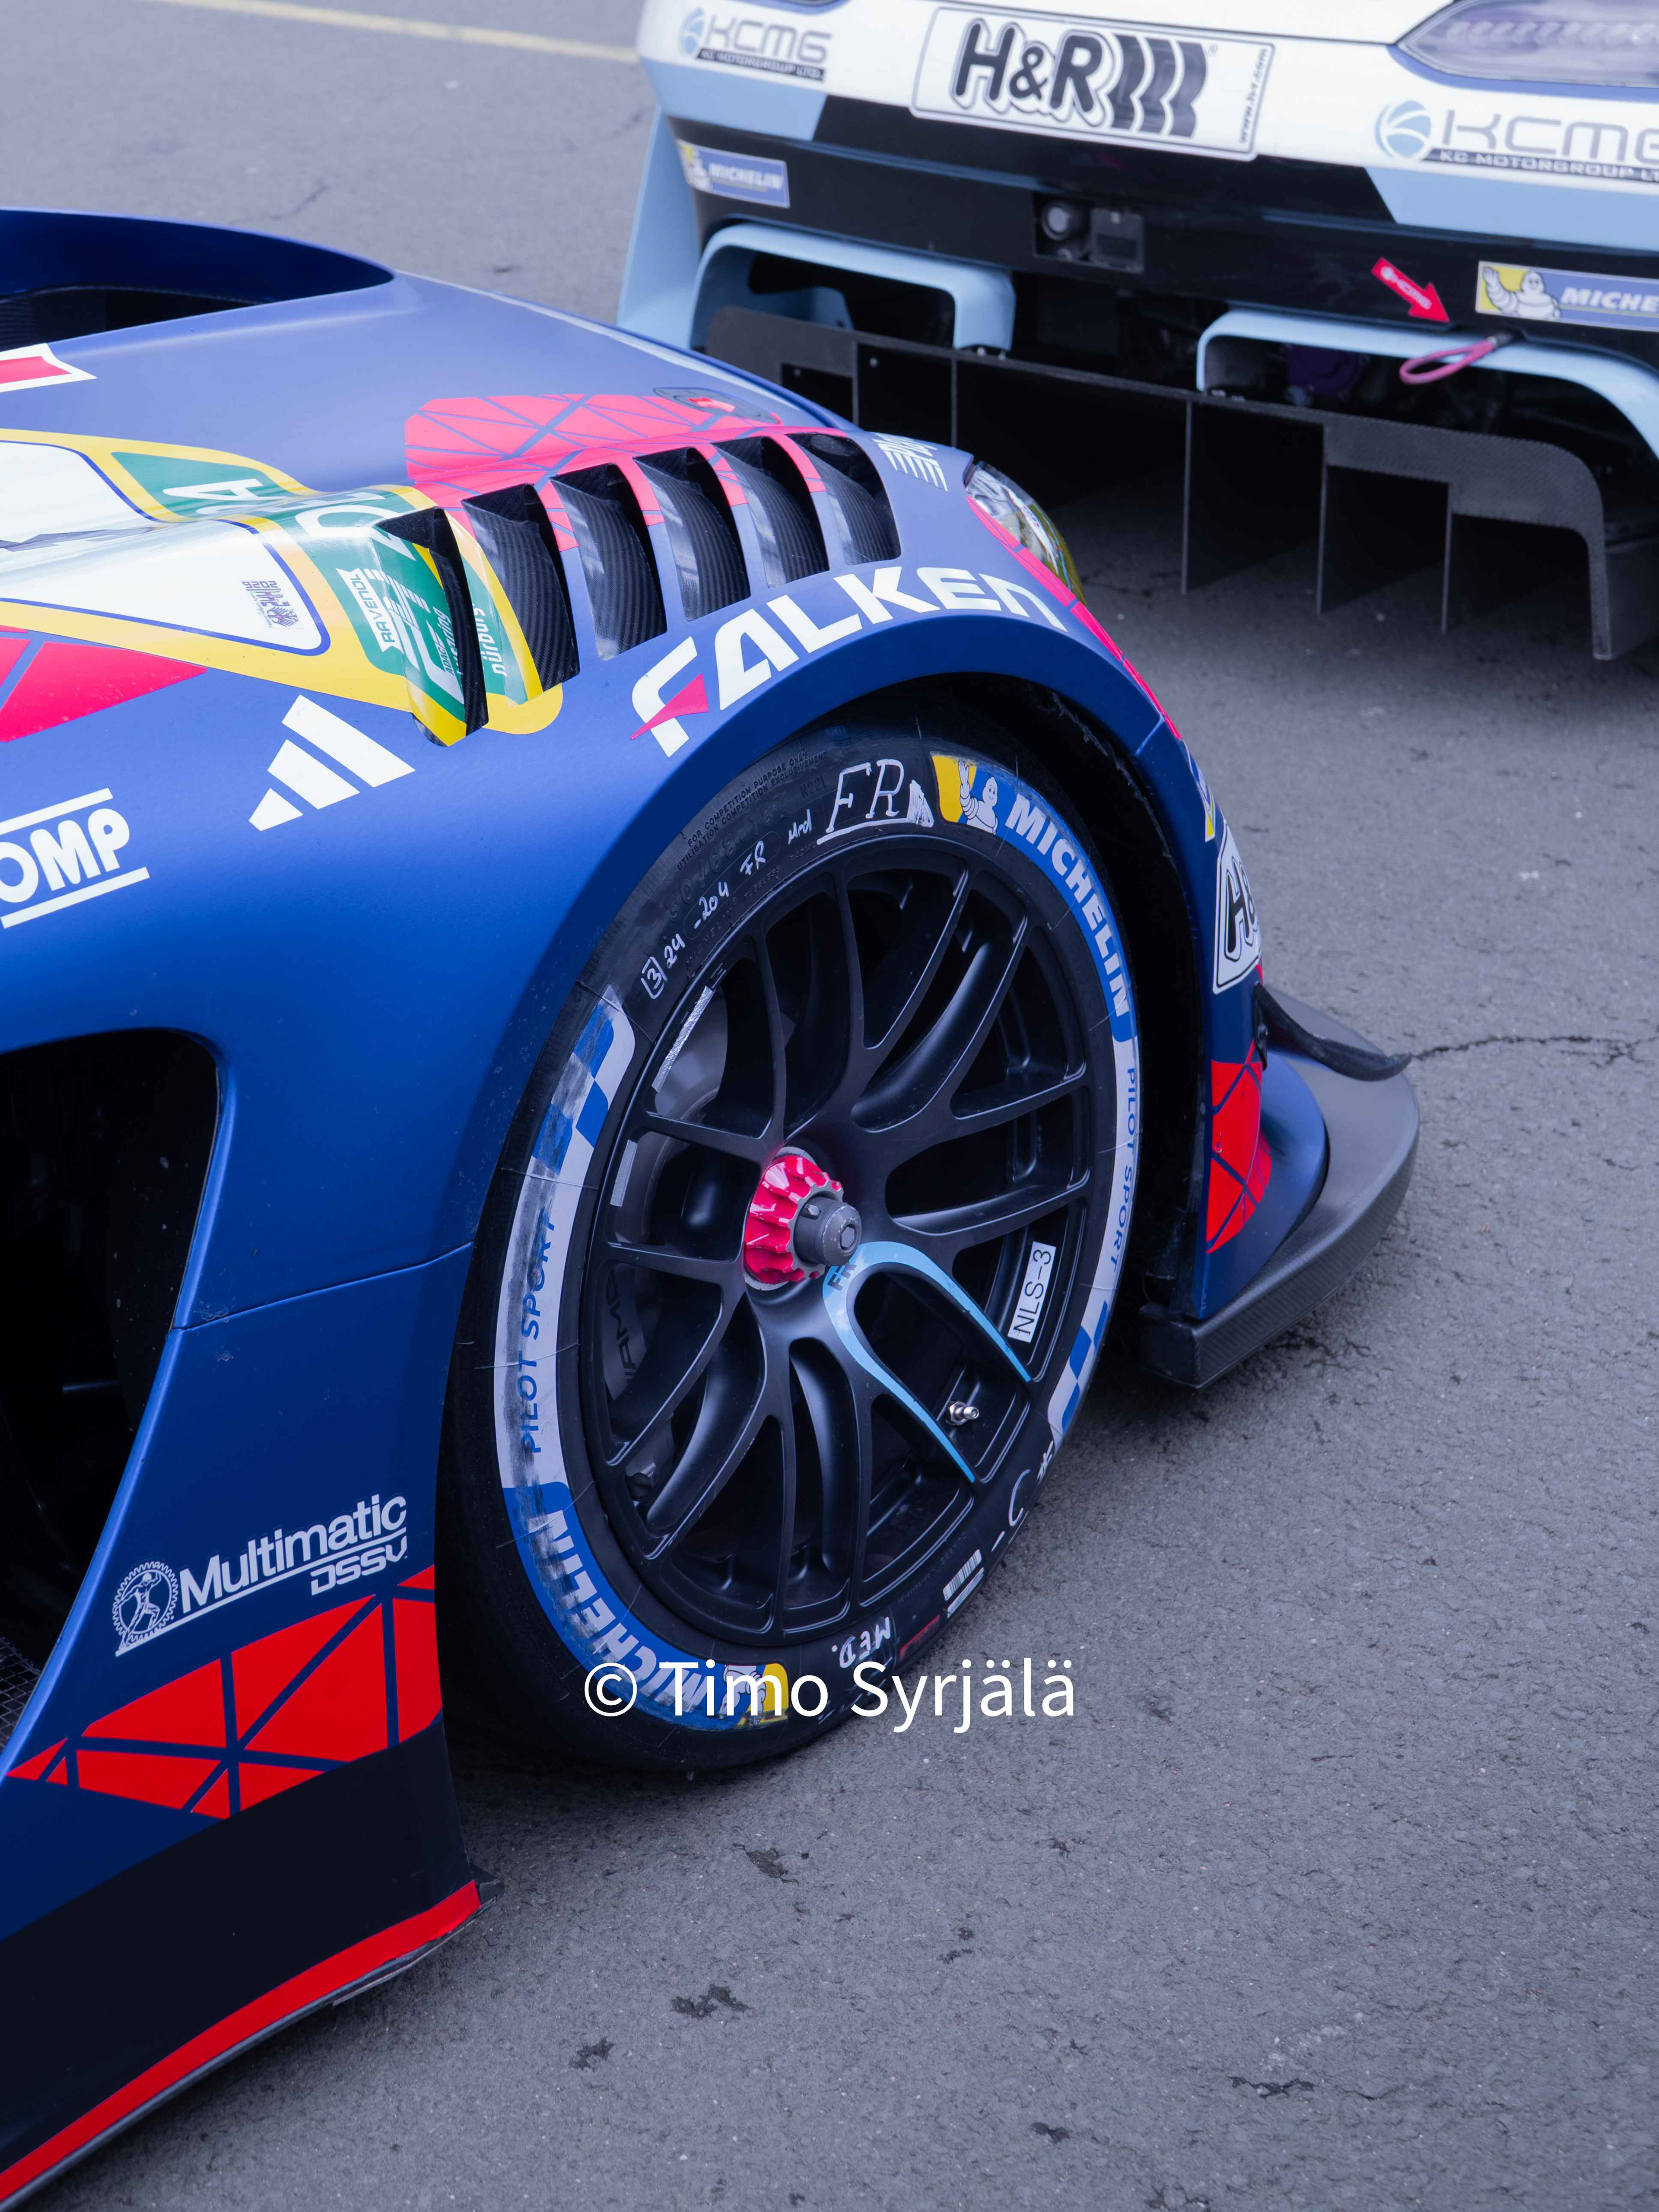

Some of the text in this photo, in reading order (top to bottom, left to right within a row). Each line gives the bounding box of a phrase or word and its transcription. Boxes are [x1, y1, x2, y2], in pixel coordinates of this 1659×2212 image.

[704, 15, 832, 64] KCMG
[953, 21, 1105, 123] H&R
[1439, 149, 1469, 164] KC
[1475, 153, 1634, 180] MOTORGROUP
[349, 573, 395, 643] RAVENOL
[437, 645, 454, 675] ADAC
[632, 566, 1068, 758] FALKEN
[677, 751, 827, 871] UTILISATION COMPETITION EXCLUSIVEMENT
[688, 751, 808, 848] FOR COMPETITION PURPOSE ONLY
[0, 807, 130, 903] OMP
[1005, 793, 1130, 1017] MICHELIN
[1110, 1068, 1136, 1272] PILOT SPORT
[1012, 1249, 1052, 1335] NLS-3
[518, 1350, 541, 1453] PILOT
[180, 1493, 407, 1615] Multimatic
[311, 1535, 408, 1596] DSSV
[528, 1510, 714, 1714] MICHELIN
